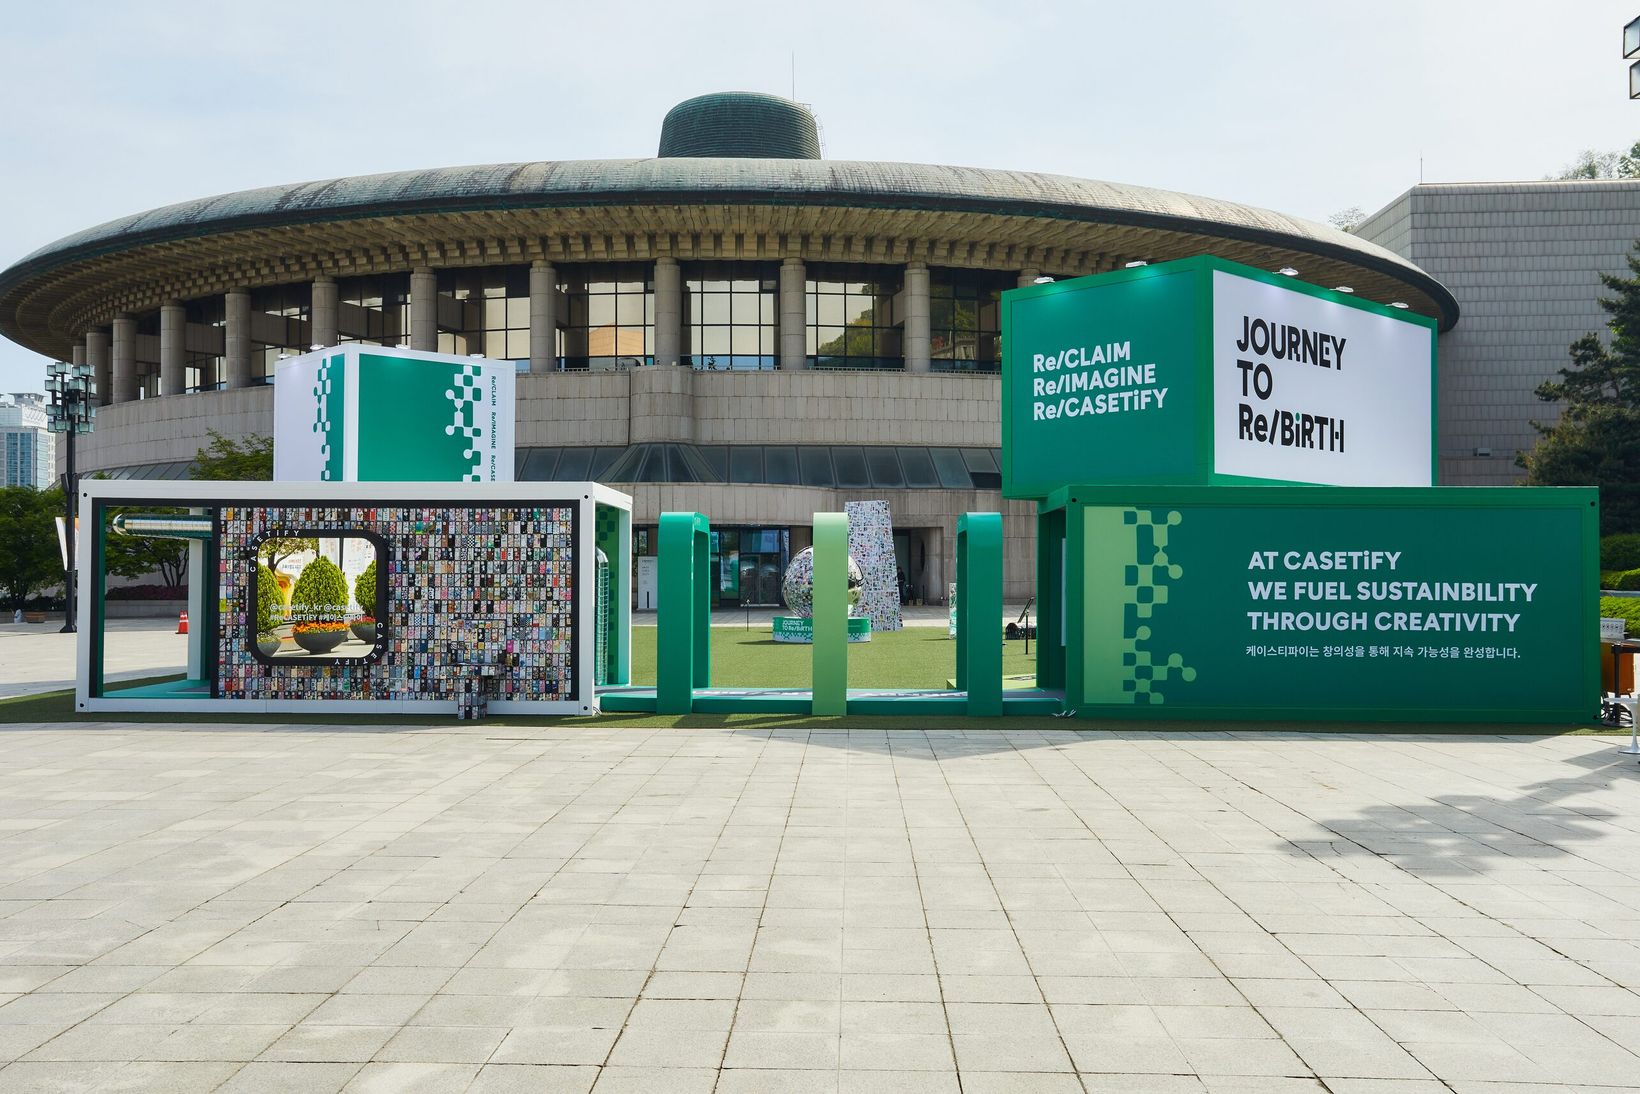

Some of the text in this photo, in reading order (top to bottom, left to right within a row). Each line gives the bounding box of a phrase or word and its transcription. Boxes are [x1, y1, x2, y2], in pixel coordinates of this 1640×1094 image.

[1033, 341, 1131, 373] Re/CLAIM
[1236, 315, 1347, 371] JOURNEY
[1033, 363, 1156, 397] Re/IMAGINE
[1236, 359, 1273, 400] TO
[1033, 387, 1169, 420] Re/CASETiFY
[1238, 403, 1345, 453] Re/BiRTH
[1247, 550, 1402, 570] AT CASETiFY
[1247, 581, 1538, 602] WE FUEL SUSTAINBILITY
[1246, 611, 1521, 632] THROUGH CREATIVITY
[1245, 645, 1521, 659] 케이스티파이는 창의성을 통해 지속 가능성을 완성합니다.
